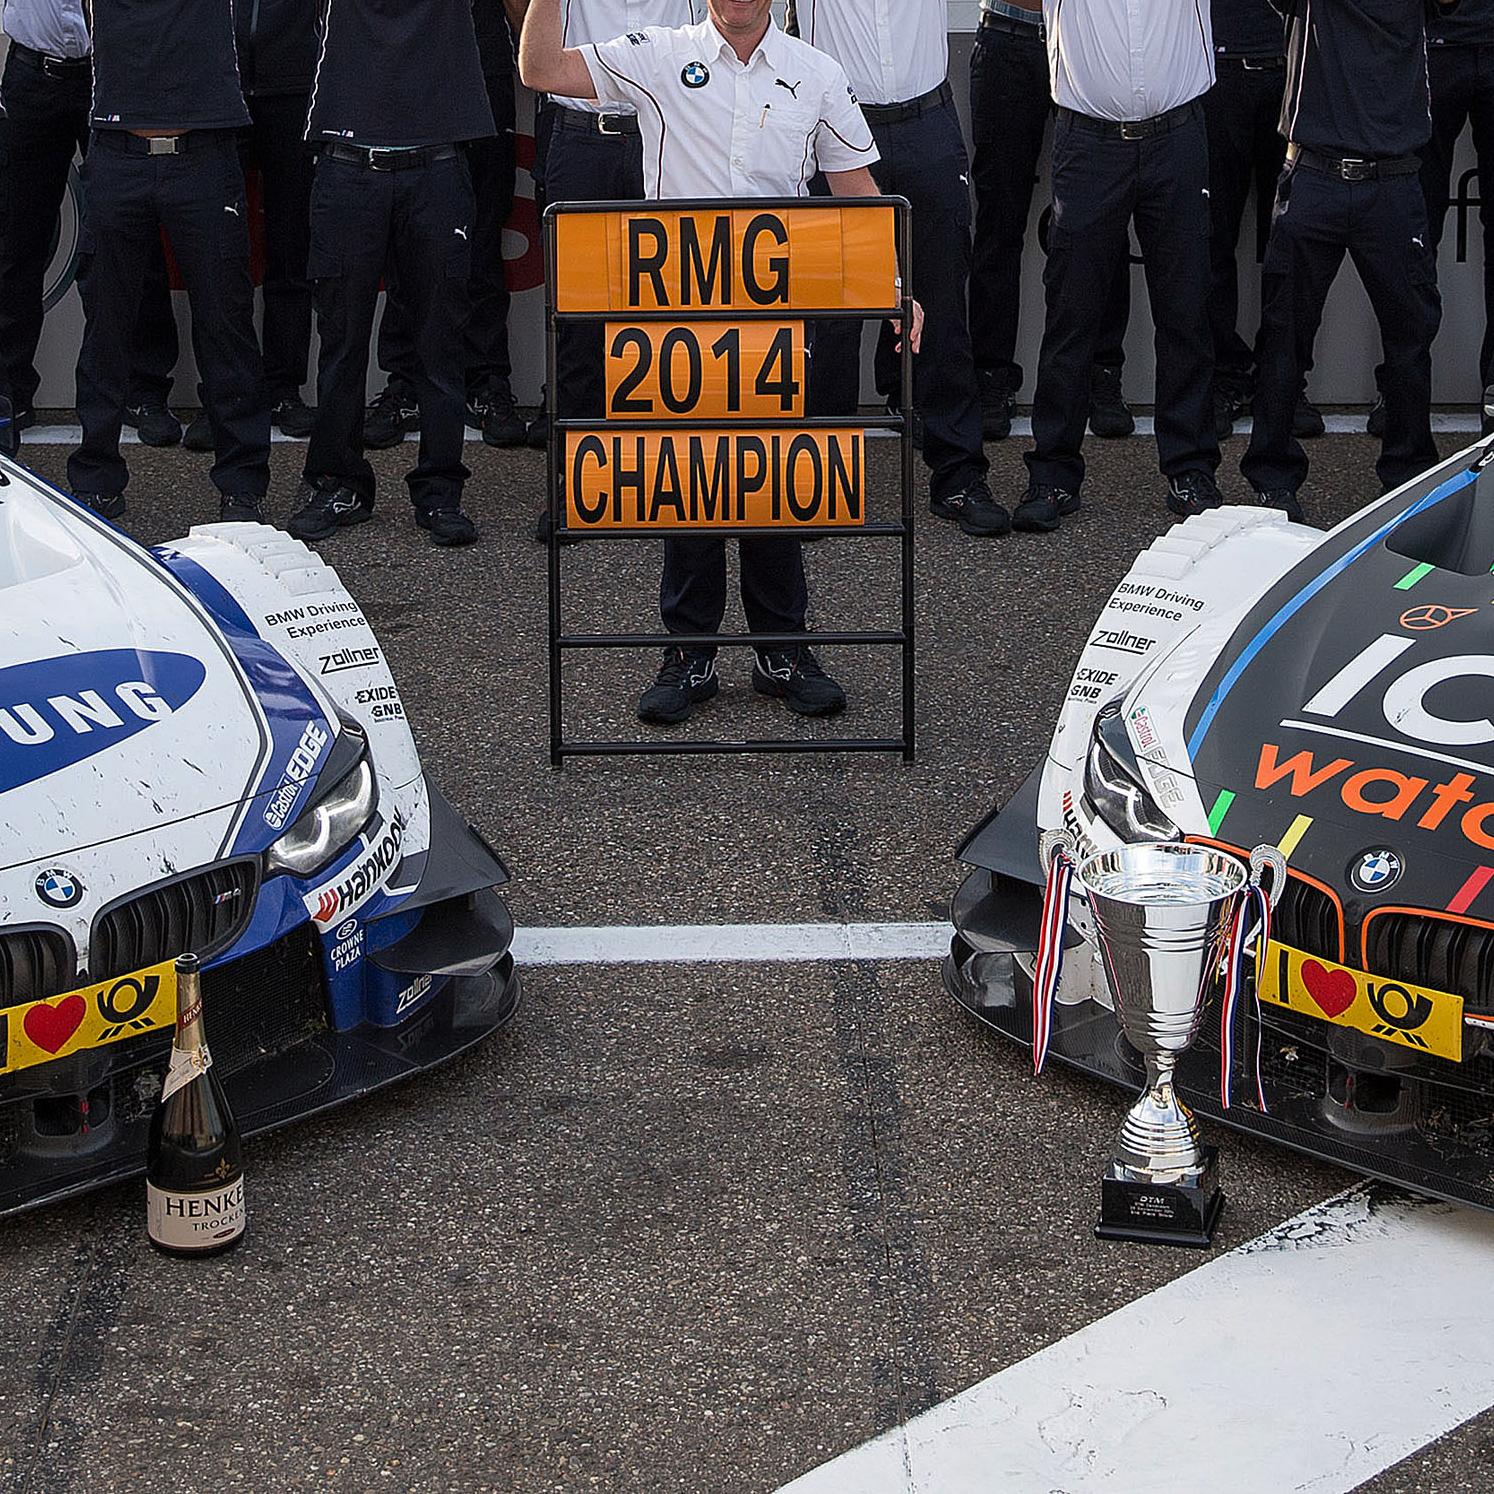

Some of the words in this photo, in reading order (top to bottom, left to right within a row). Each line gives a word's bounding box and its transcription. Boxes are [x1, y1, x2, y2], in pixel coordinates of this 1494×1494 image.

[628, 214, 791, 307] RMG
[609, 328, 799, 413] 2014
[573, 433, 861, 524] CHAMPION
[1108, 597, 1183, 622] Experience
[1118, 583, 1157, 597] BMW
[1155, 587, 1205, 612] Driving
[265, 607, 303, 627] BMW
[307, 602, 359, 619] Driving
[287, 615, 366, 640] Experience
[1077, 668, 1119, 685] EXIDE
[355, 686, 397, 704] EXIDE
[1071, 684, 1102, 699] GNB
[371, 703, 403, 717] GNB
[1133, 714, 1157, 749] Castrol
[284, 720, 327, 786] EDGE
[274, 780, 300, 828] Castrol
[331, 930, 364, 961] CROWNE
[335, 947, 361, 971] PLAZA
[1280, 948, 1289, 1006] I
[1139, 1195, 1165, 1205] DTM
